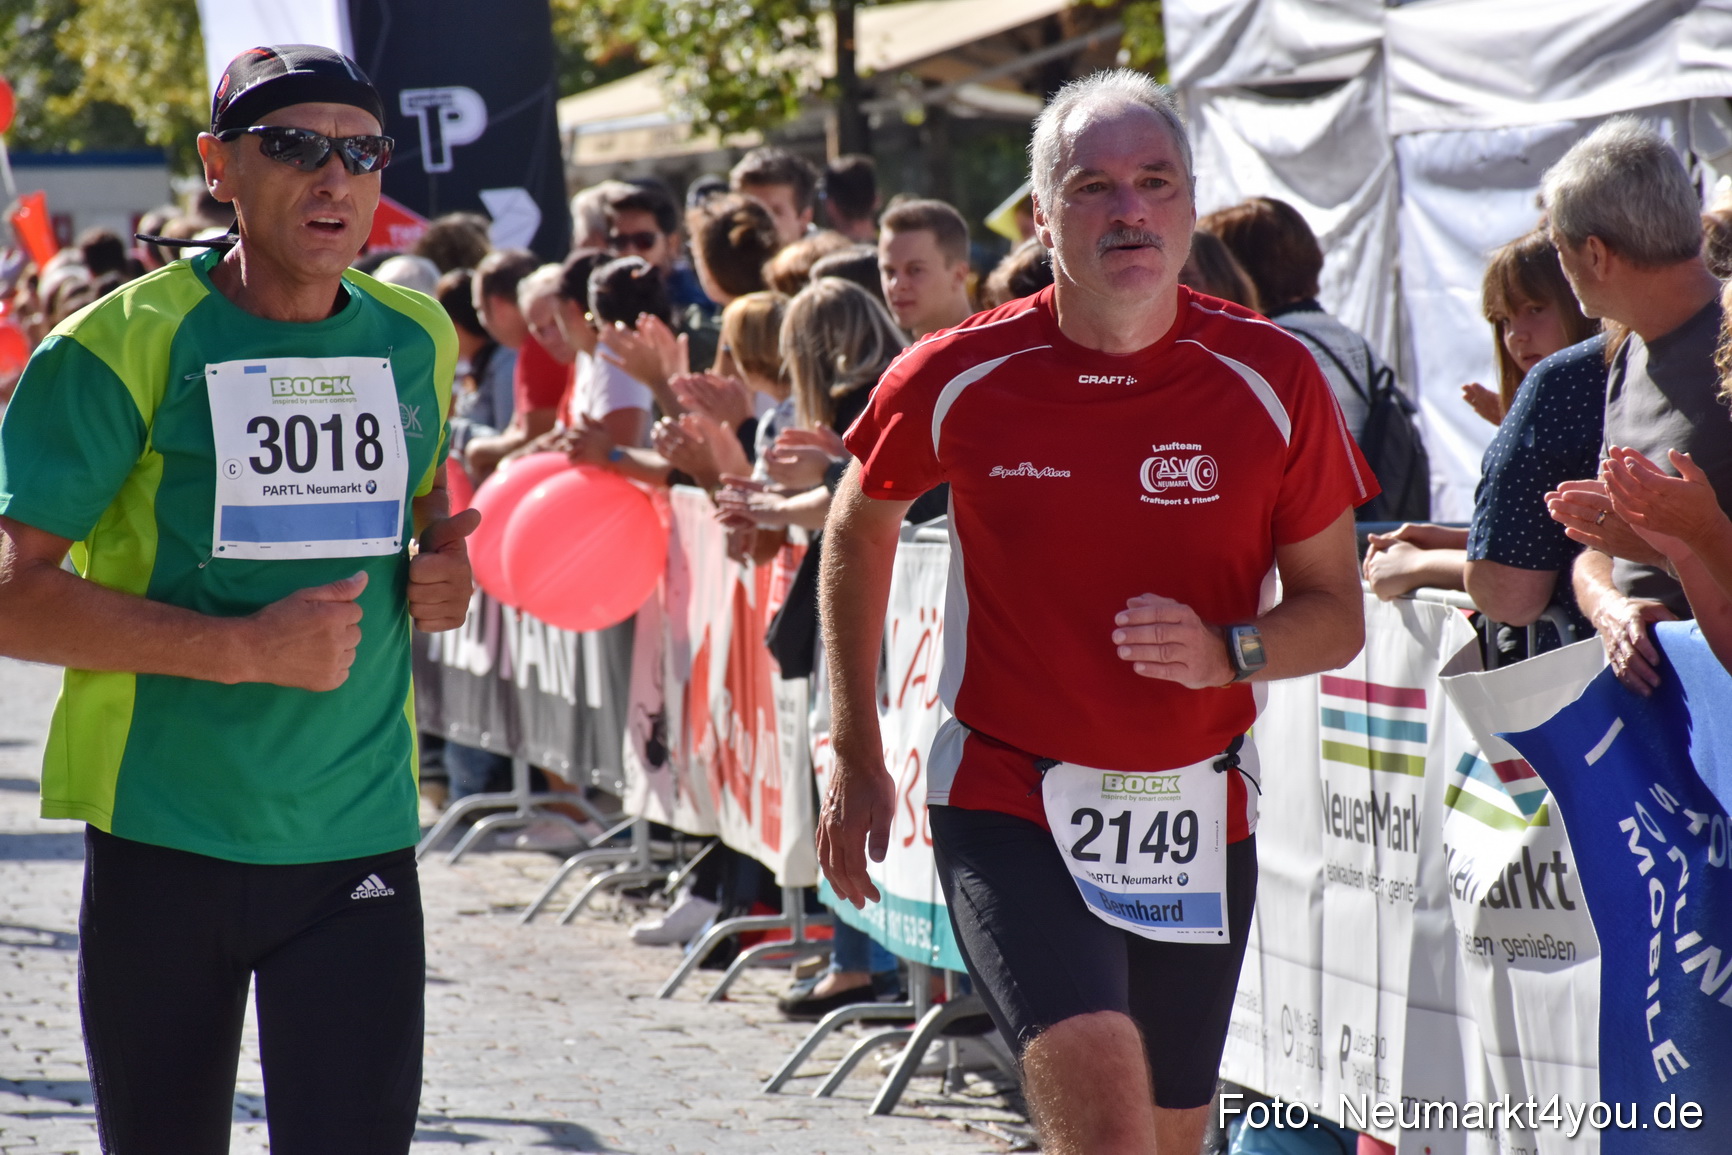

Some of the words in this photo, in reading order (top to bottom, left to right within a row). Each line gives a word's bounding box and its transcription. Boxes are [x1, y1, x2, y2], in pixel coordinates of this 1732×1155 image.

[1078, 374, 1125, 385] CRAFT
[270, 376, 354, 397] BOCK
[246, 412, 384, 475] 3018
[1152, 442, 1202, 453] Laufteam
[229, 464, 236, 475] C
[989, 465, 1025, 479] Sport
[1036, 466, 1071, 479] More
[1160, 457, 1189, 479] ASV
[262, 485, 304, 496] PARTL
[306, 483, 362, 494] Neumarkt
[1157, 480, 1189, 488] NEUMARKT
[1140, 494, 1182, 506] Kraftsport
[1192, 494, 1220, 504] Fitness
[1102, 773, 1181, 794] BOCK
[1101, 793, 1128, 802] inspired
[1070, 807, 1199, 865] 2149
[1121, 874, 1172, 885] Neumarkt
[351, 887, 395, 900] adidas
[1100, 893, 1183, 922] Bernhard
[1501, 933, 1576, 963] genießen
[1618, 816, 1691, 1083] MOBILE
